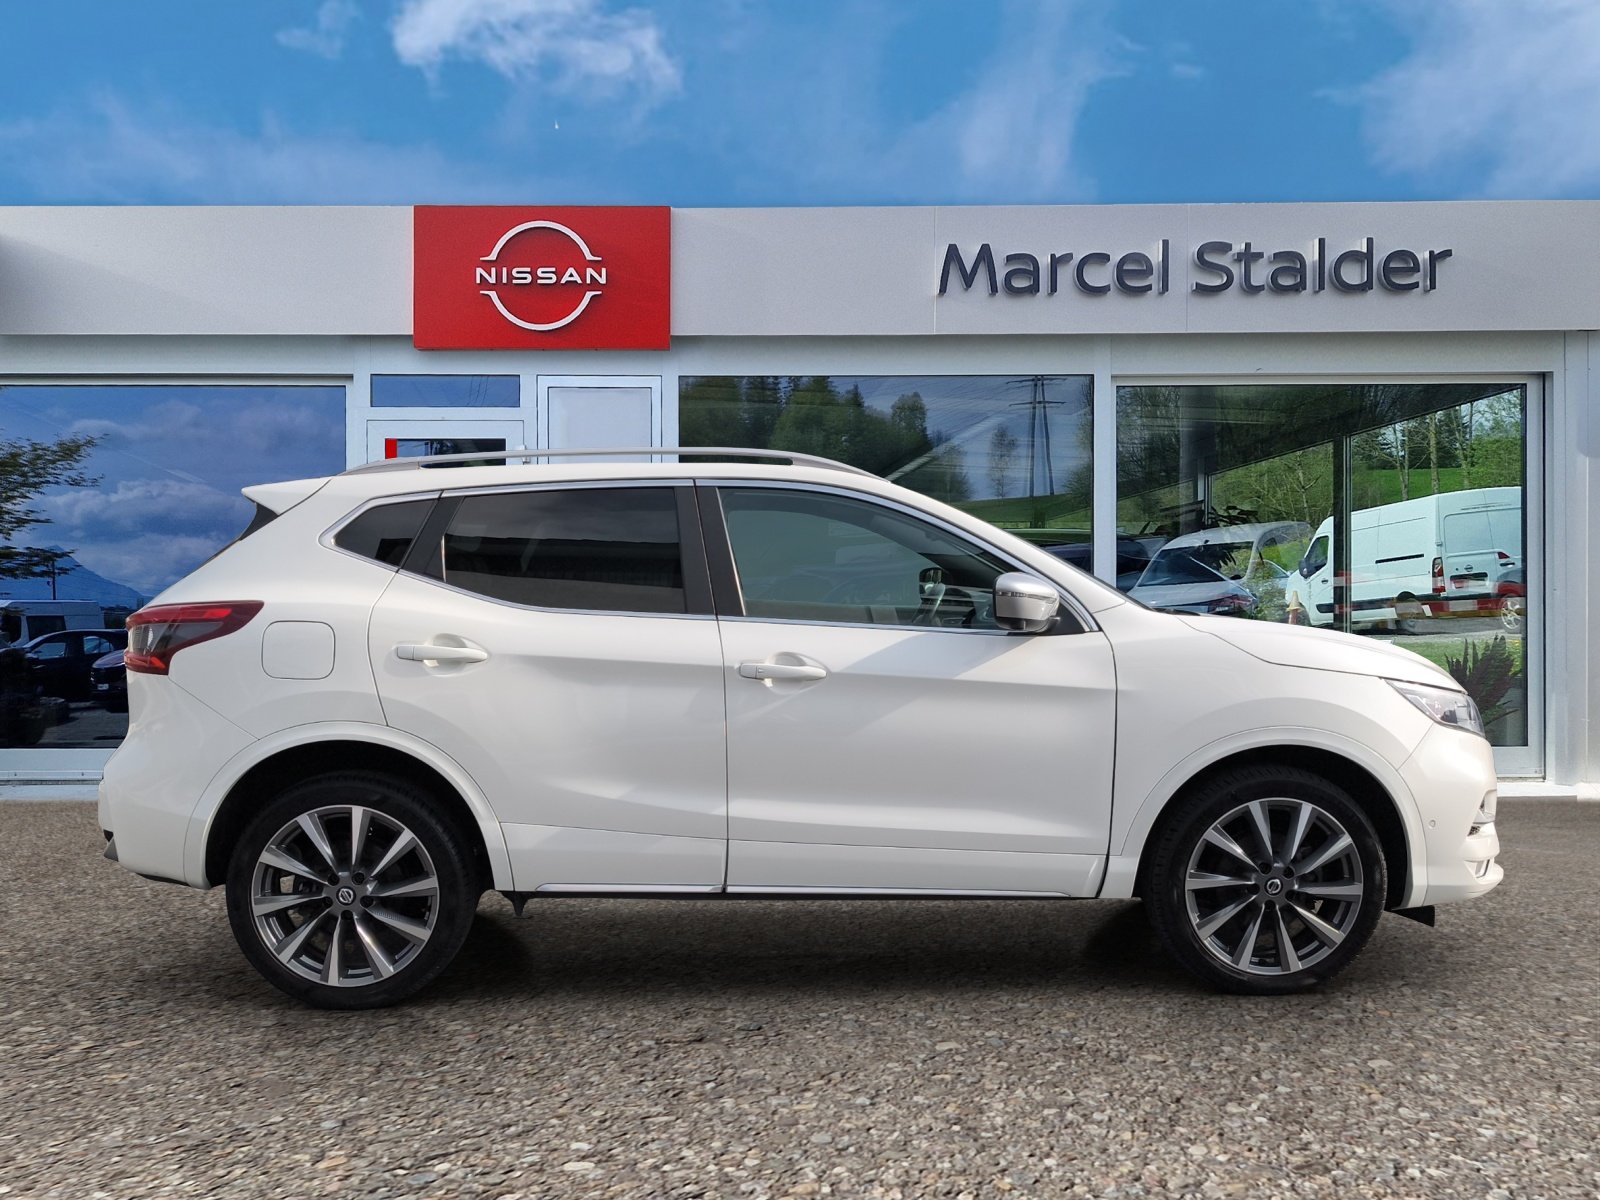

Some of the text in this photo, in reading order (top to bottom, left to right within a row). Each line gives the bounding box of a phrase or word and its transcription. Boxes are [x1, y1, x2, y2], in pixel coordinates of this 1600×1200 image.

[475, 267, 607, 285] NISSAN
[938, 237, 1452, 295] Marcel Stalder
